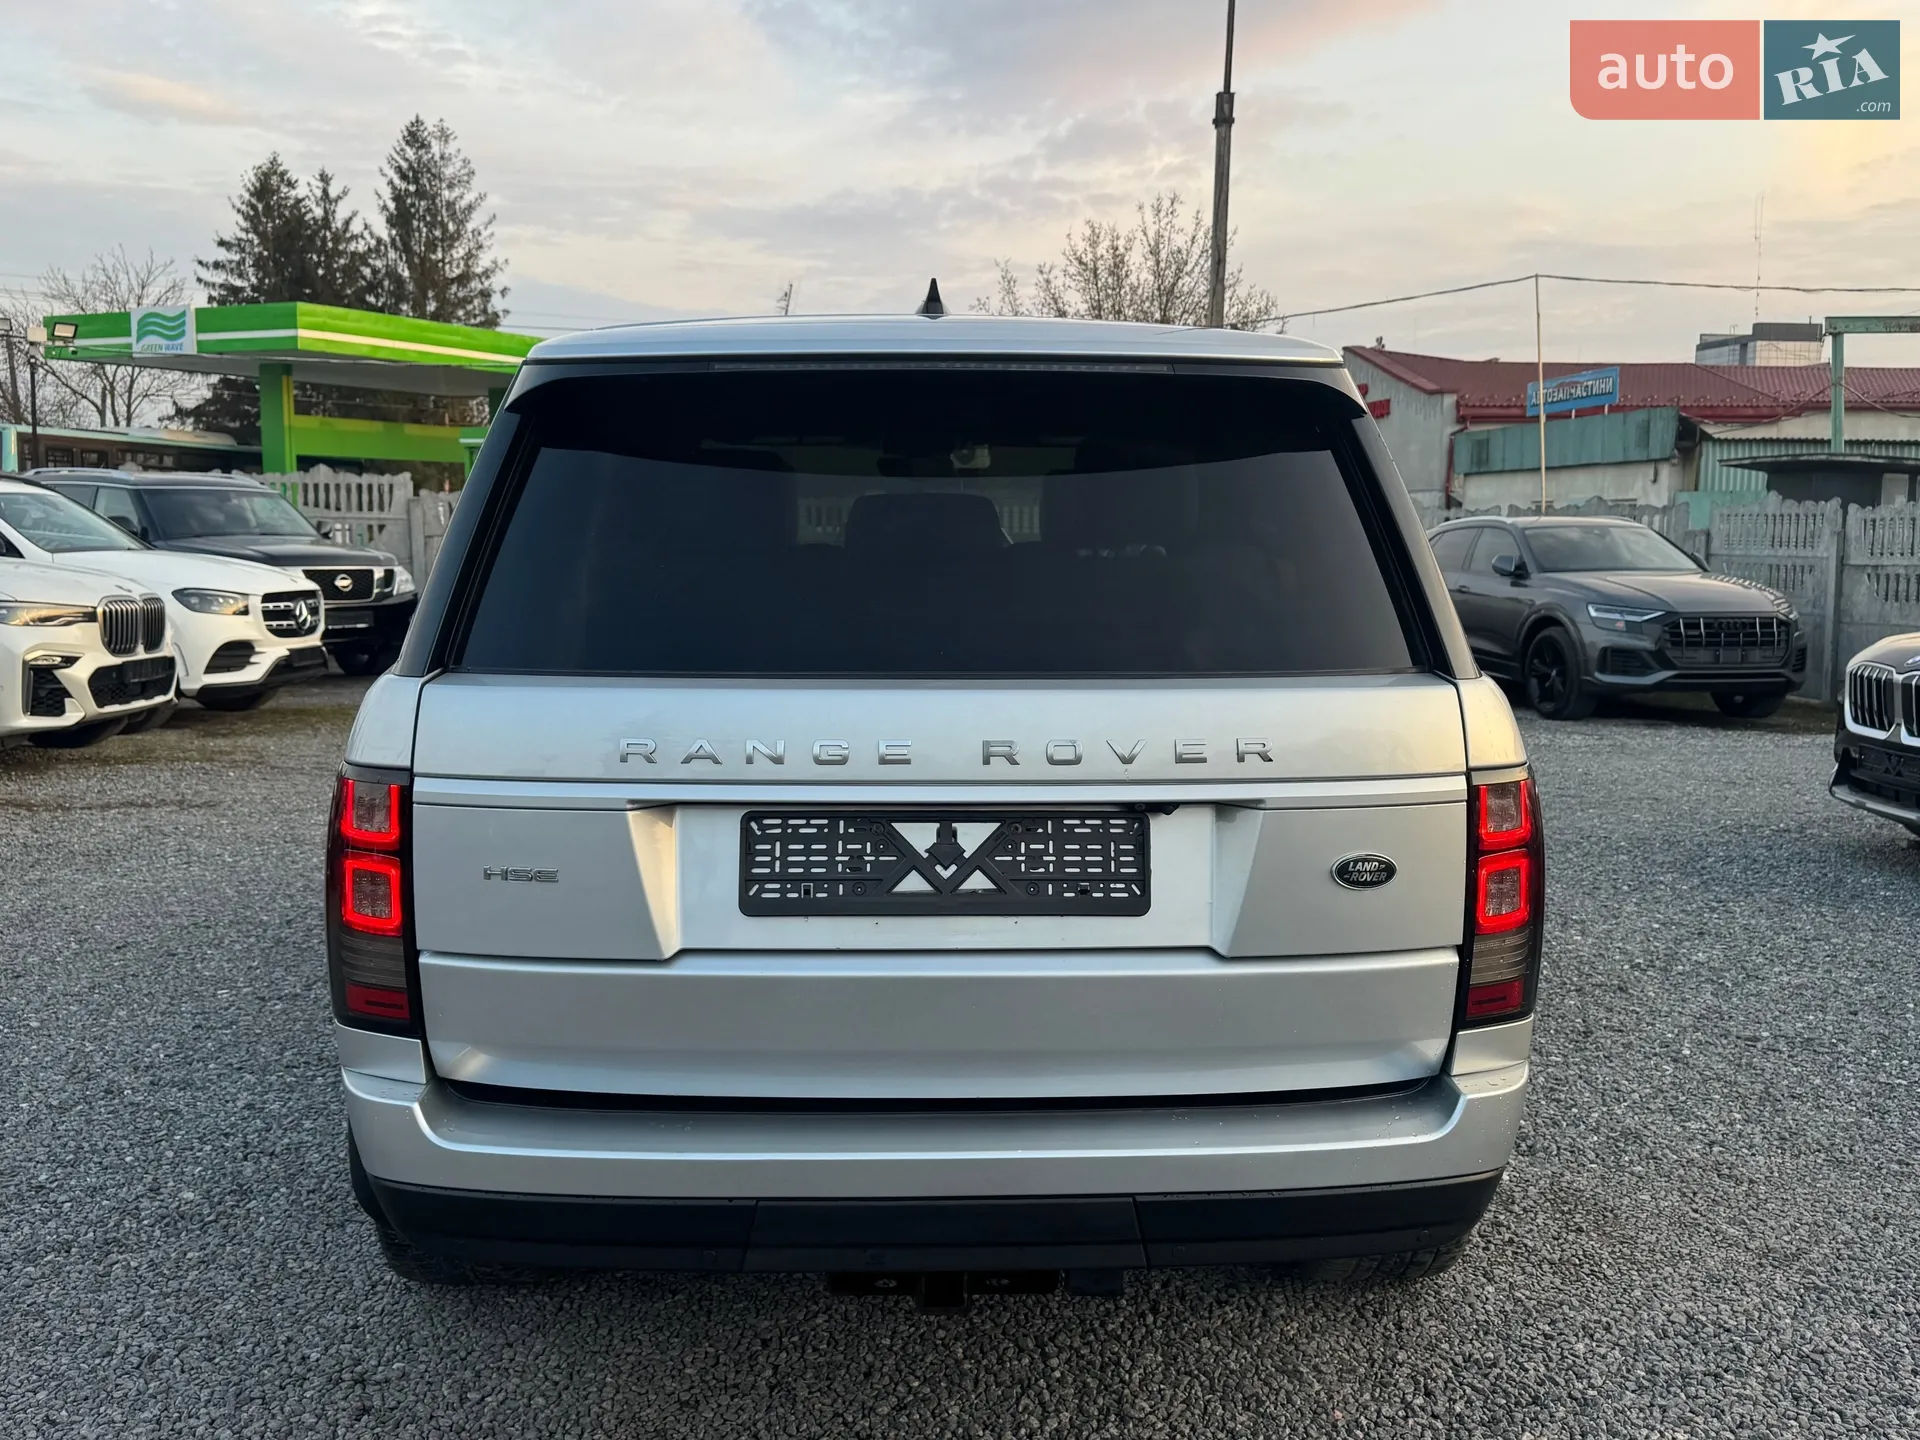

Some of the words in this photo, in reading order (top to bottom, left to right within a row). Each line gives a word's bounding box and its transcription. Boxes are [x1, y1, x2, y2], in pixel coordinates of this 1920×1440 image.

[140, 343, 164, 353] GREEN
[164, 342, 184, 352] WAVE
[619, 737, 912, 766] RANGE
[982, 736, 1275, 766] ROVER
[483, 865, 559, 883] HSE
